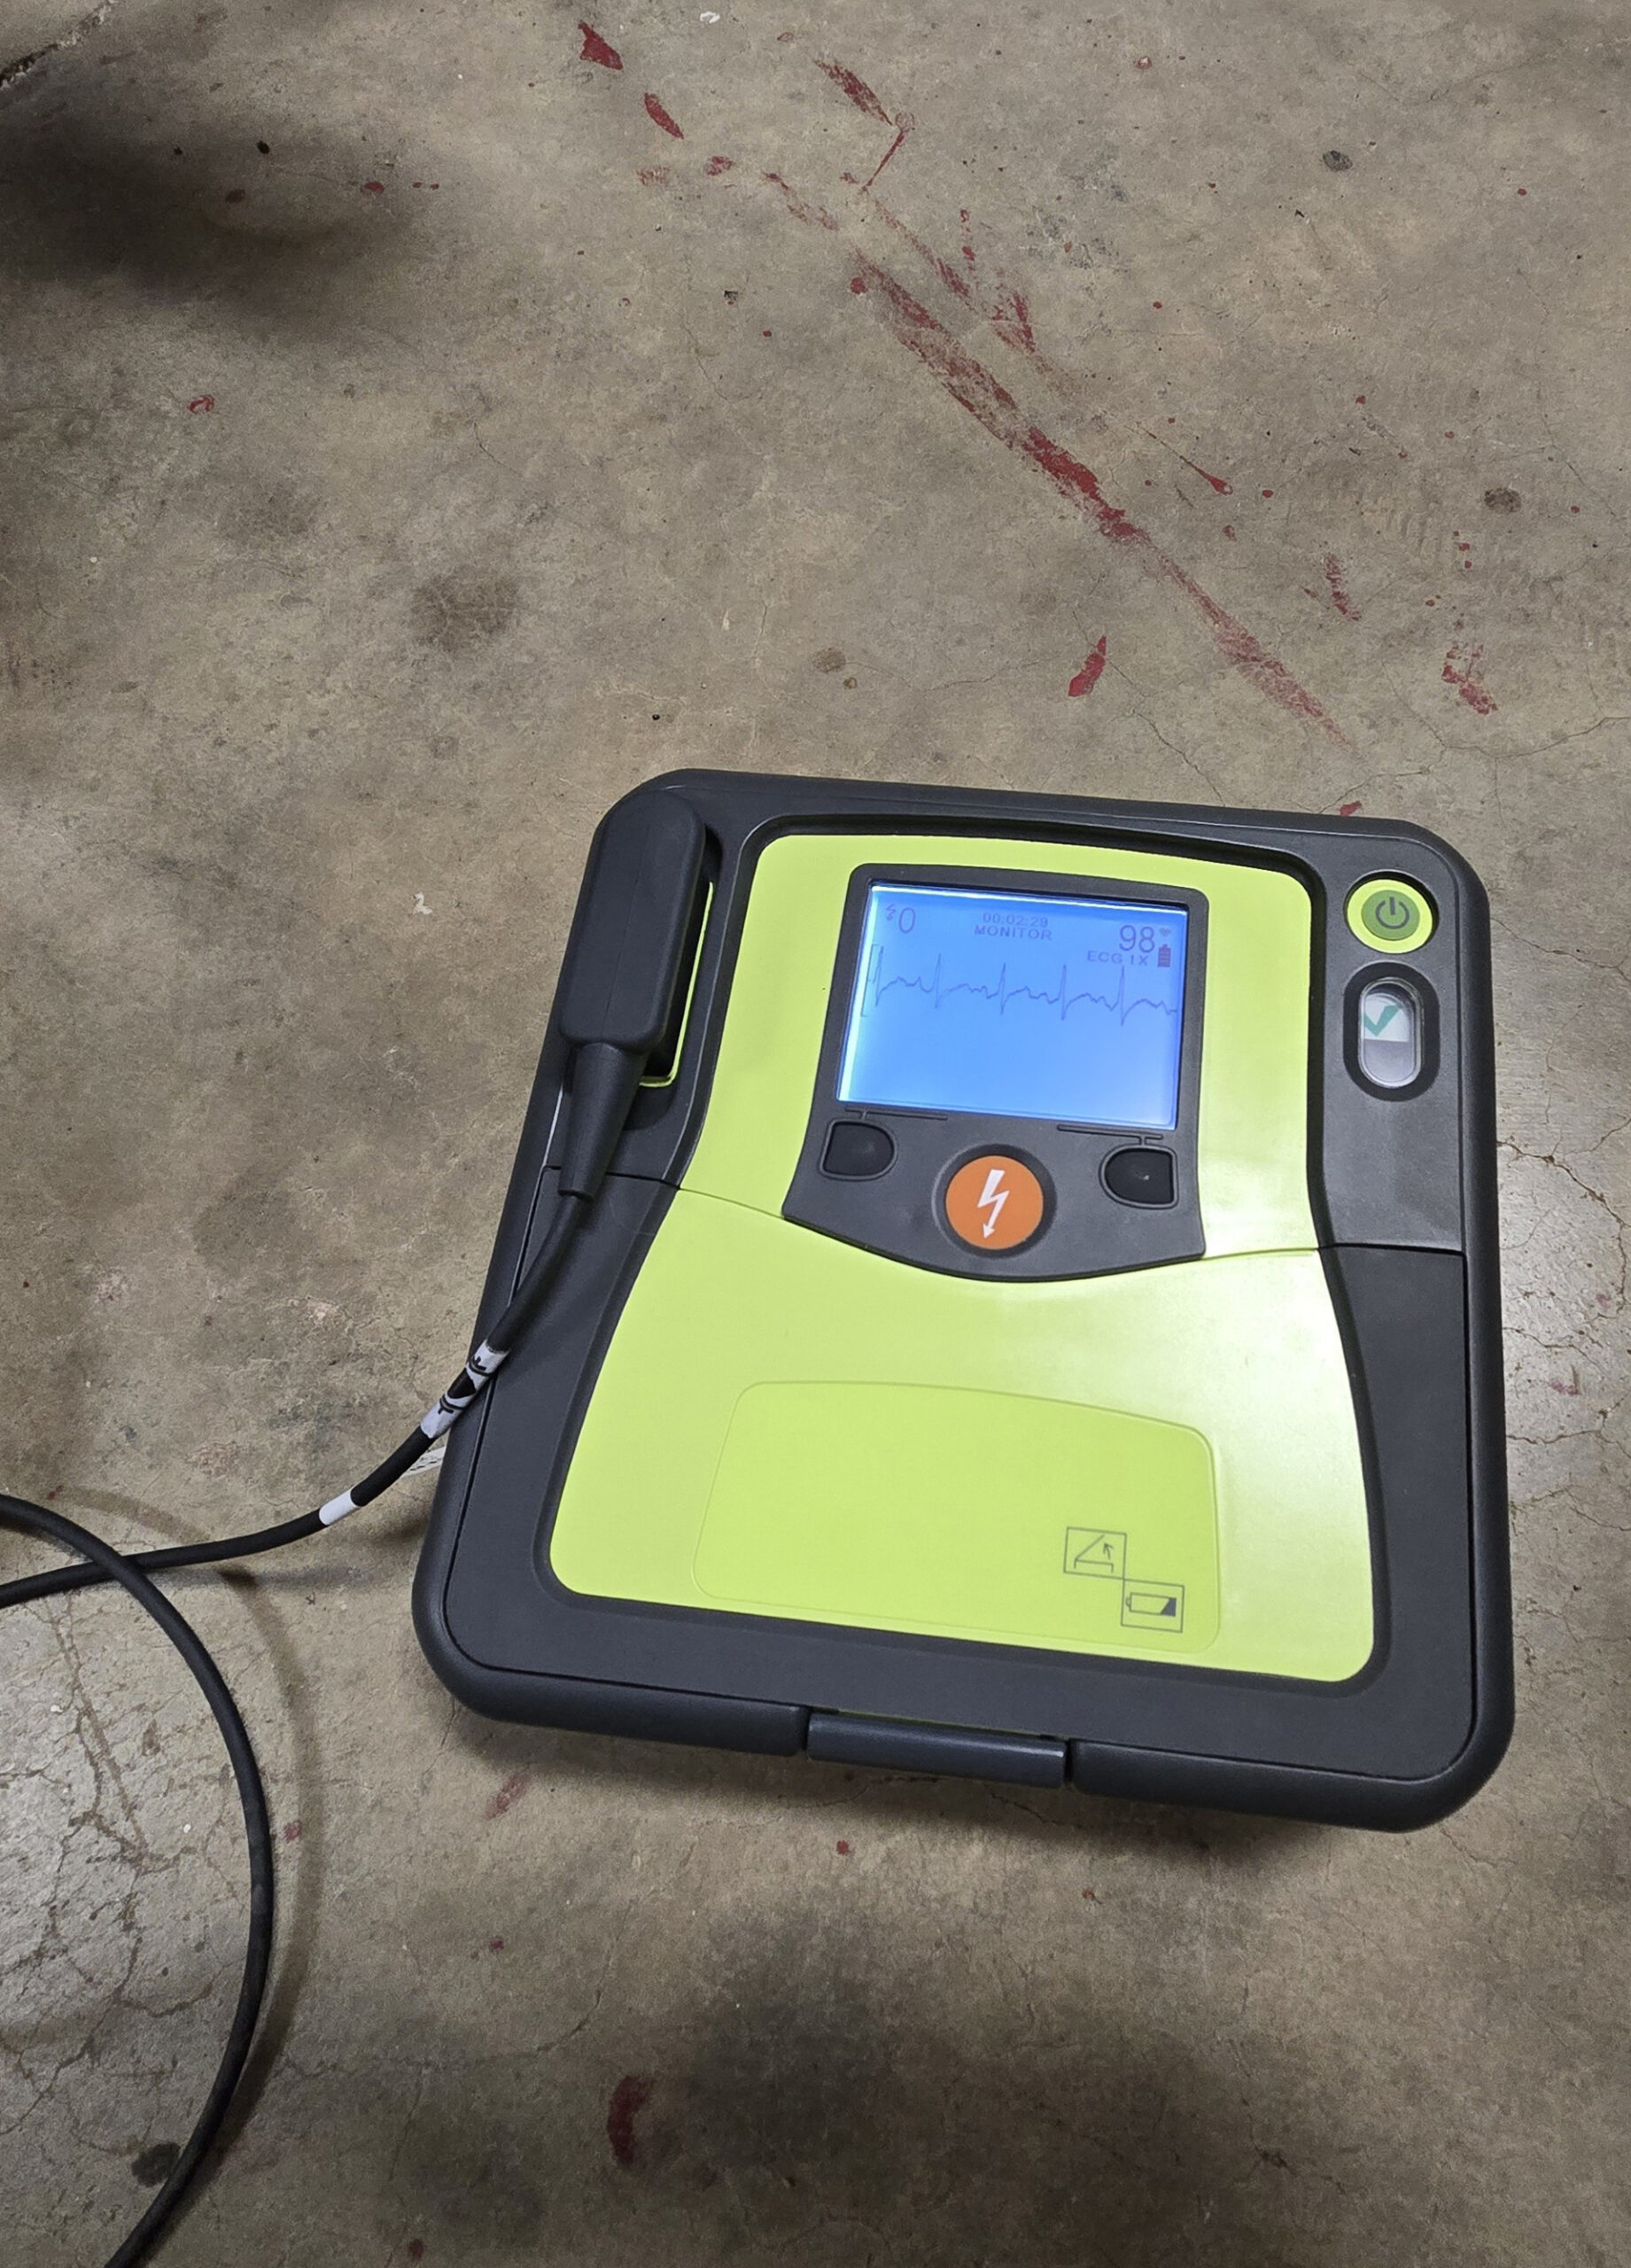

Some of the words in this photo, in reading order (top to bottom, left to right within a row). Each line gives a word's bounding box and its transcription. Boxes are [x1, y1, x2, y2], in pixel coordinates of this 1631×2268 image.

[898, 907, 916, 934] 0
[974, 924, 1052, 940] MONITOR
[1118, 924, 1155, 952] 98
[1086, 950, 1122, 964] ECG
